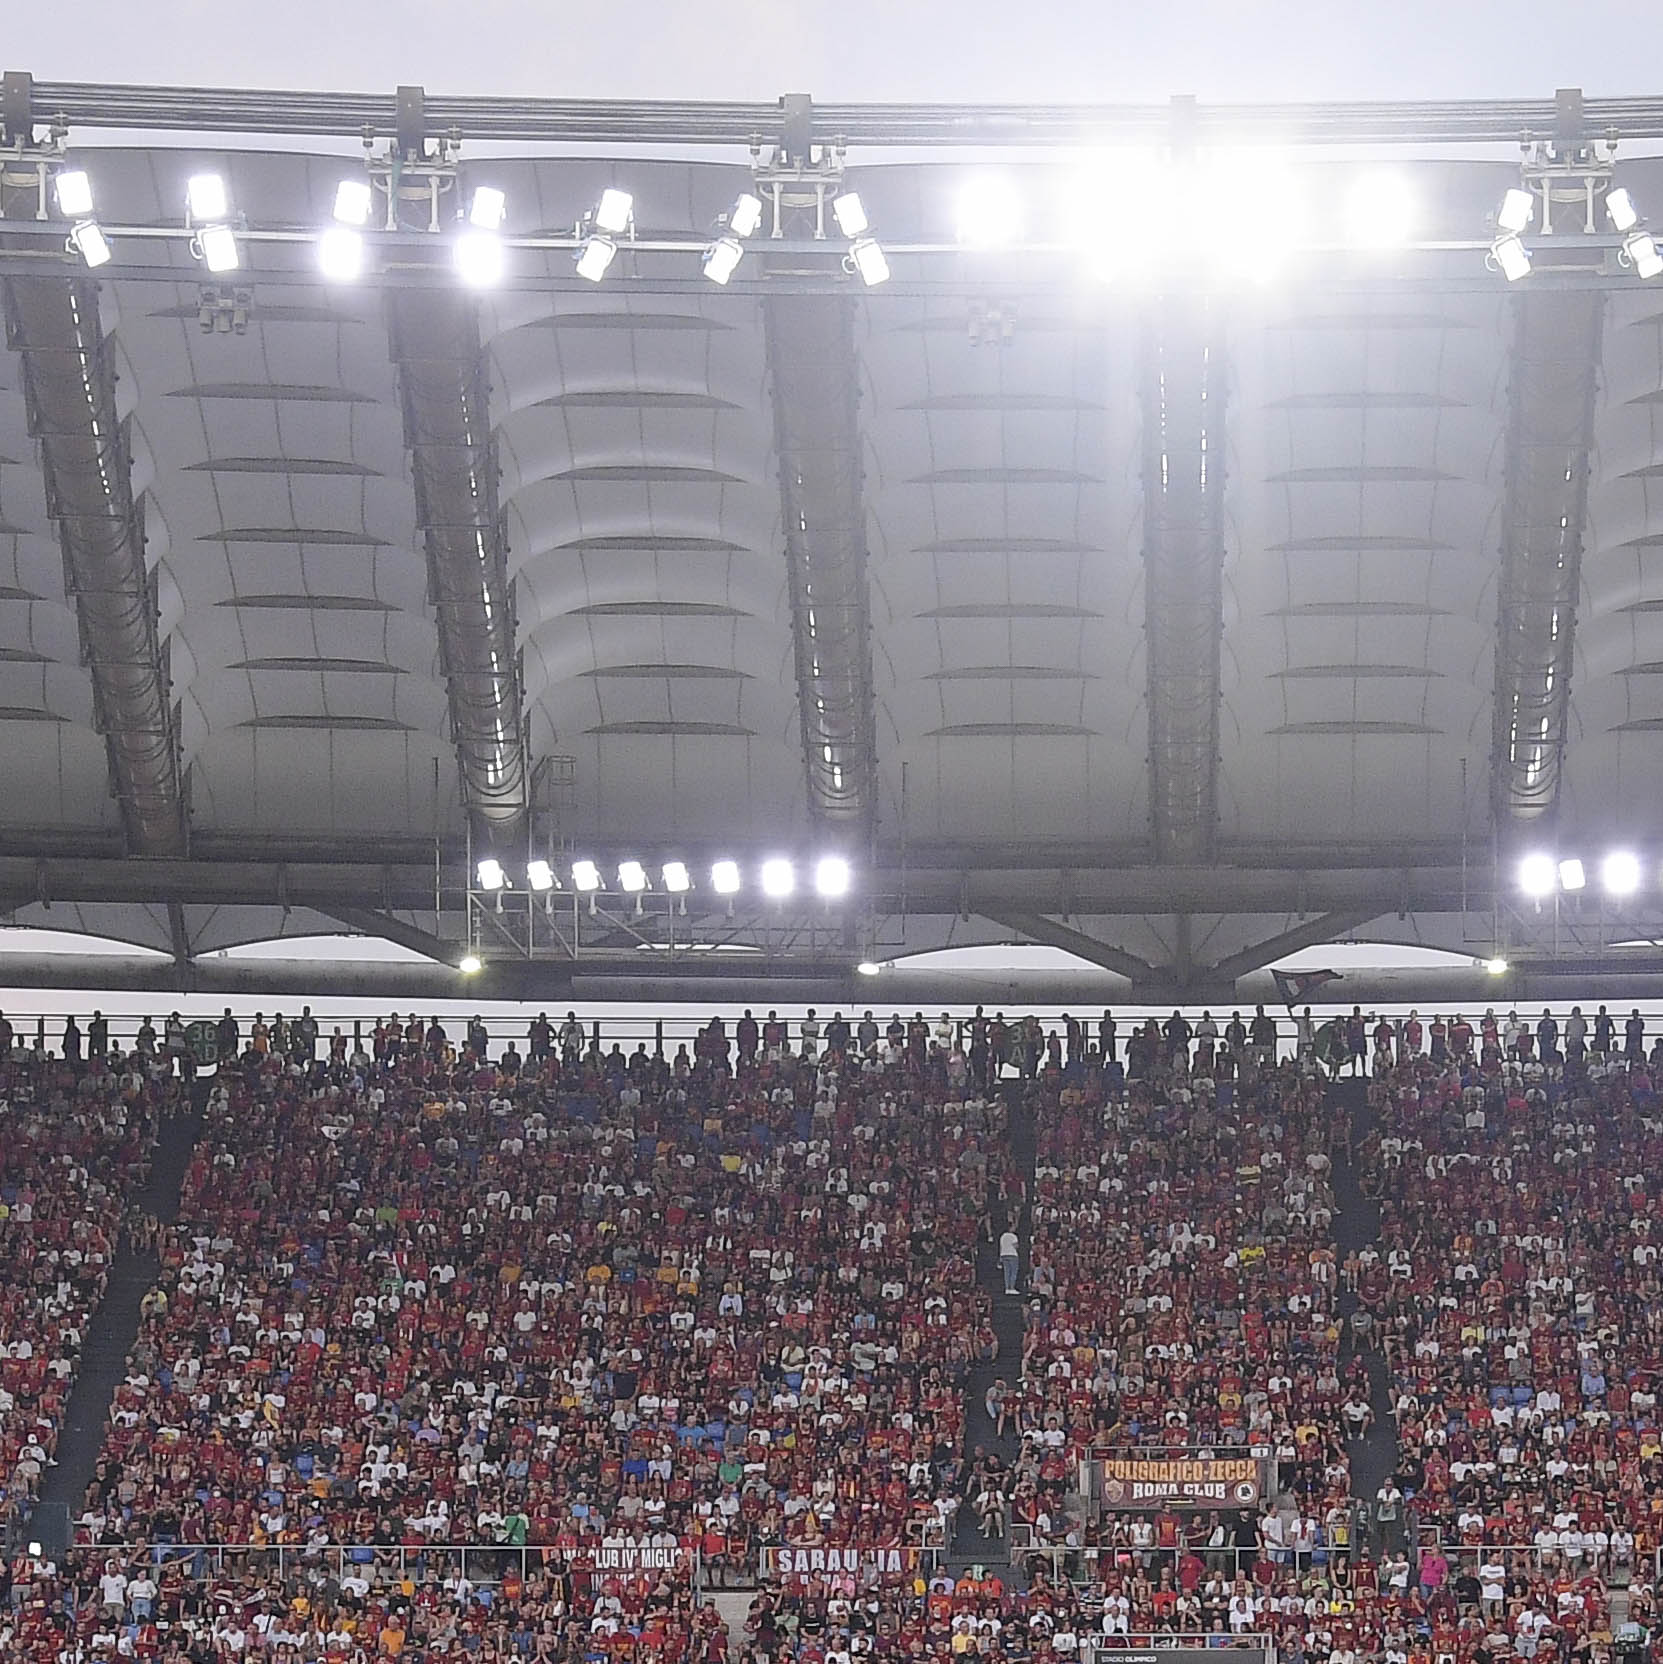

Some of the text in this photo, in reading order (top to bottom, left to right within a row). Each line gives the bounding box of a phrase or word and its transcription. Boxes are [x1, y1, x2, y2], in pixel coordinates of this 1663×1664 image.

[1105, 1460, 1257, 1481] POLIGRAFICO-ZECCA
[1133, 1483, 1226, 1499] ROMA CLUB
